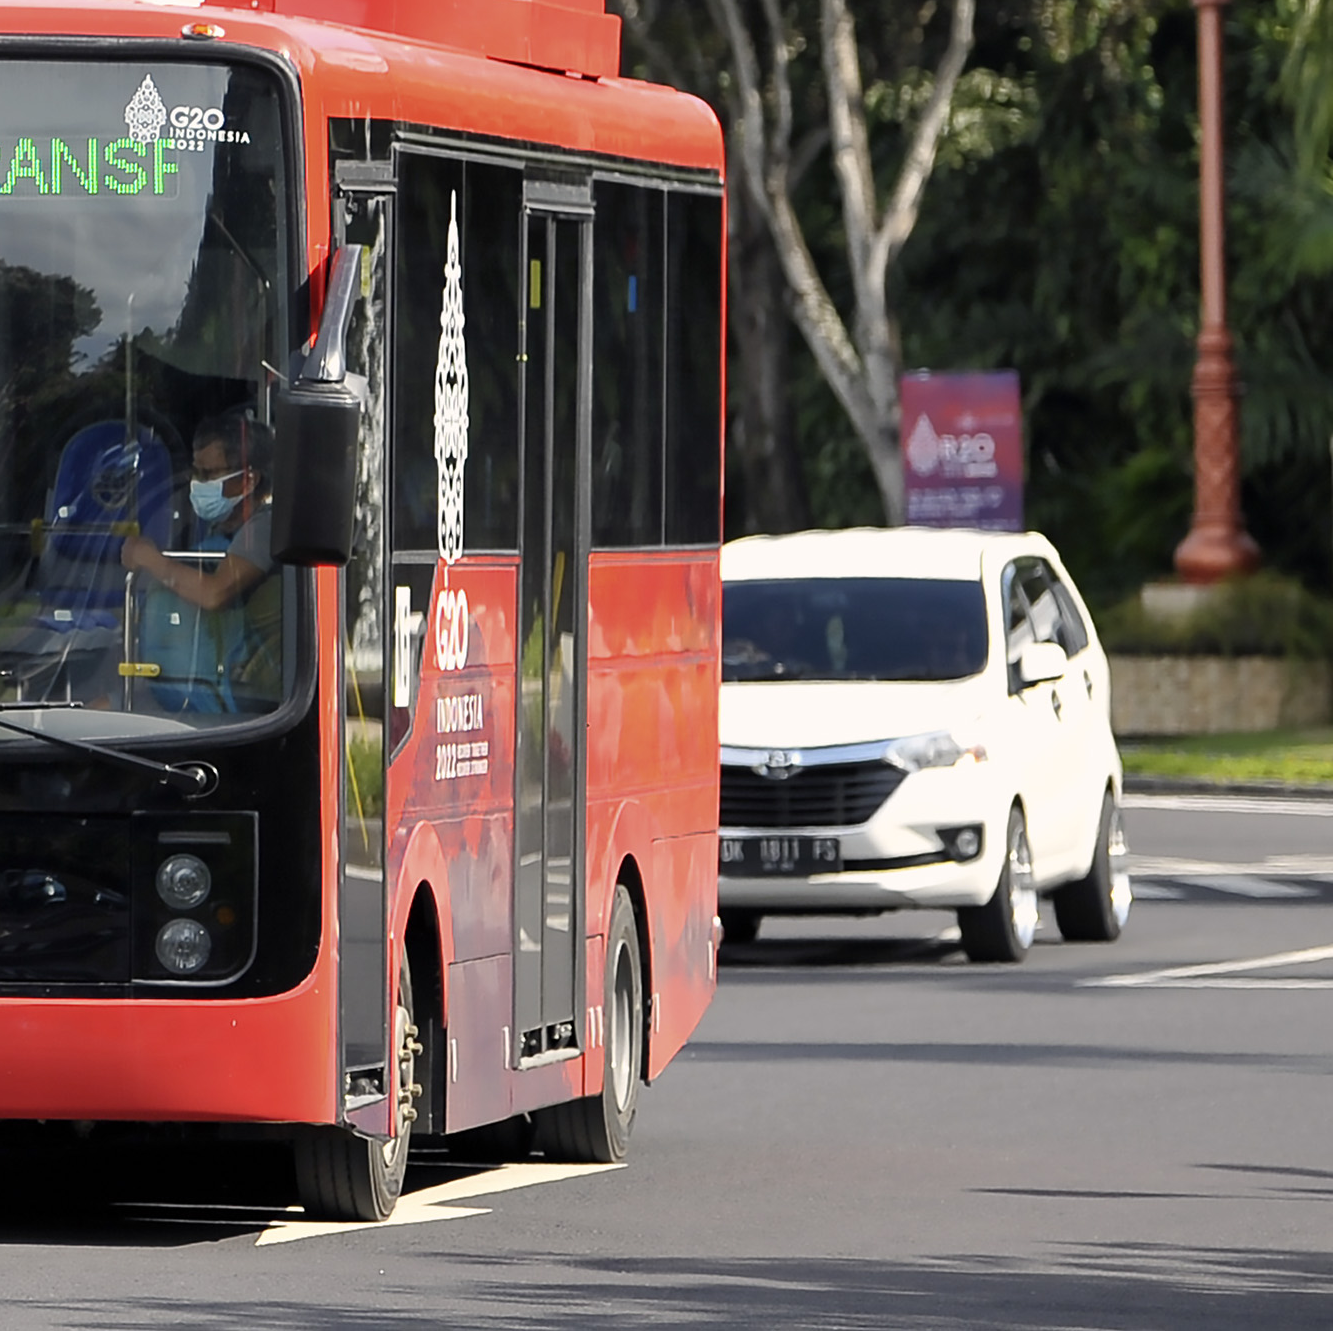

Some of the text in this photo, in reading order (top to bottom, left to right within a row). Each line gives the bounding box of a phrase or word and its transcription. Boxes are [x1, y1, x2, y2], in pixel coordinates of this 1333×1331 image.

[170, 106, 225, 130] G20
[169, 127, 250, 144] INDONESIA
[435, 589, 468, 671] G20
[436, 694, 483, 734] INDONESIA
